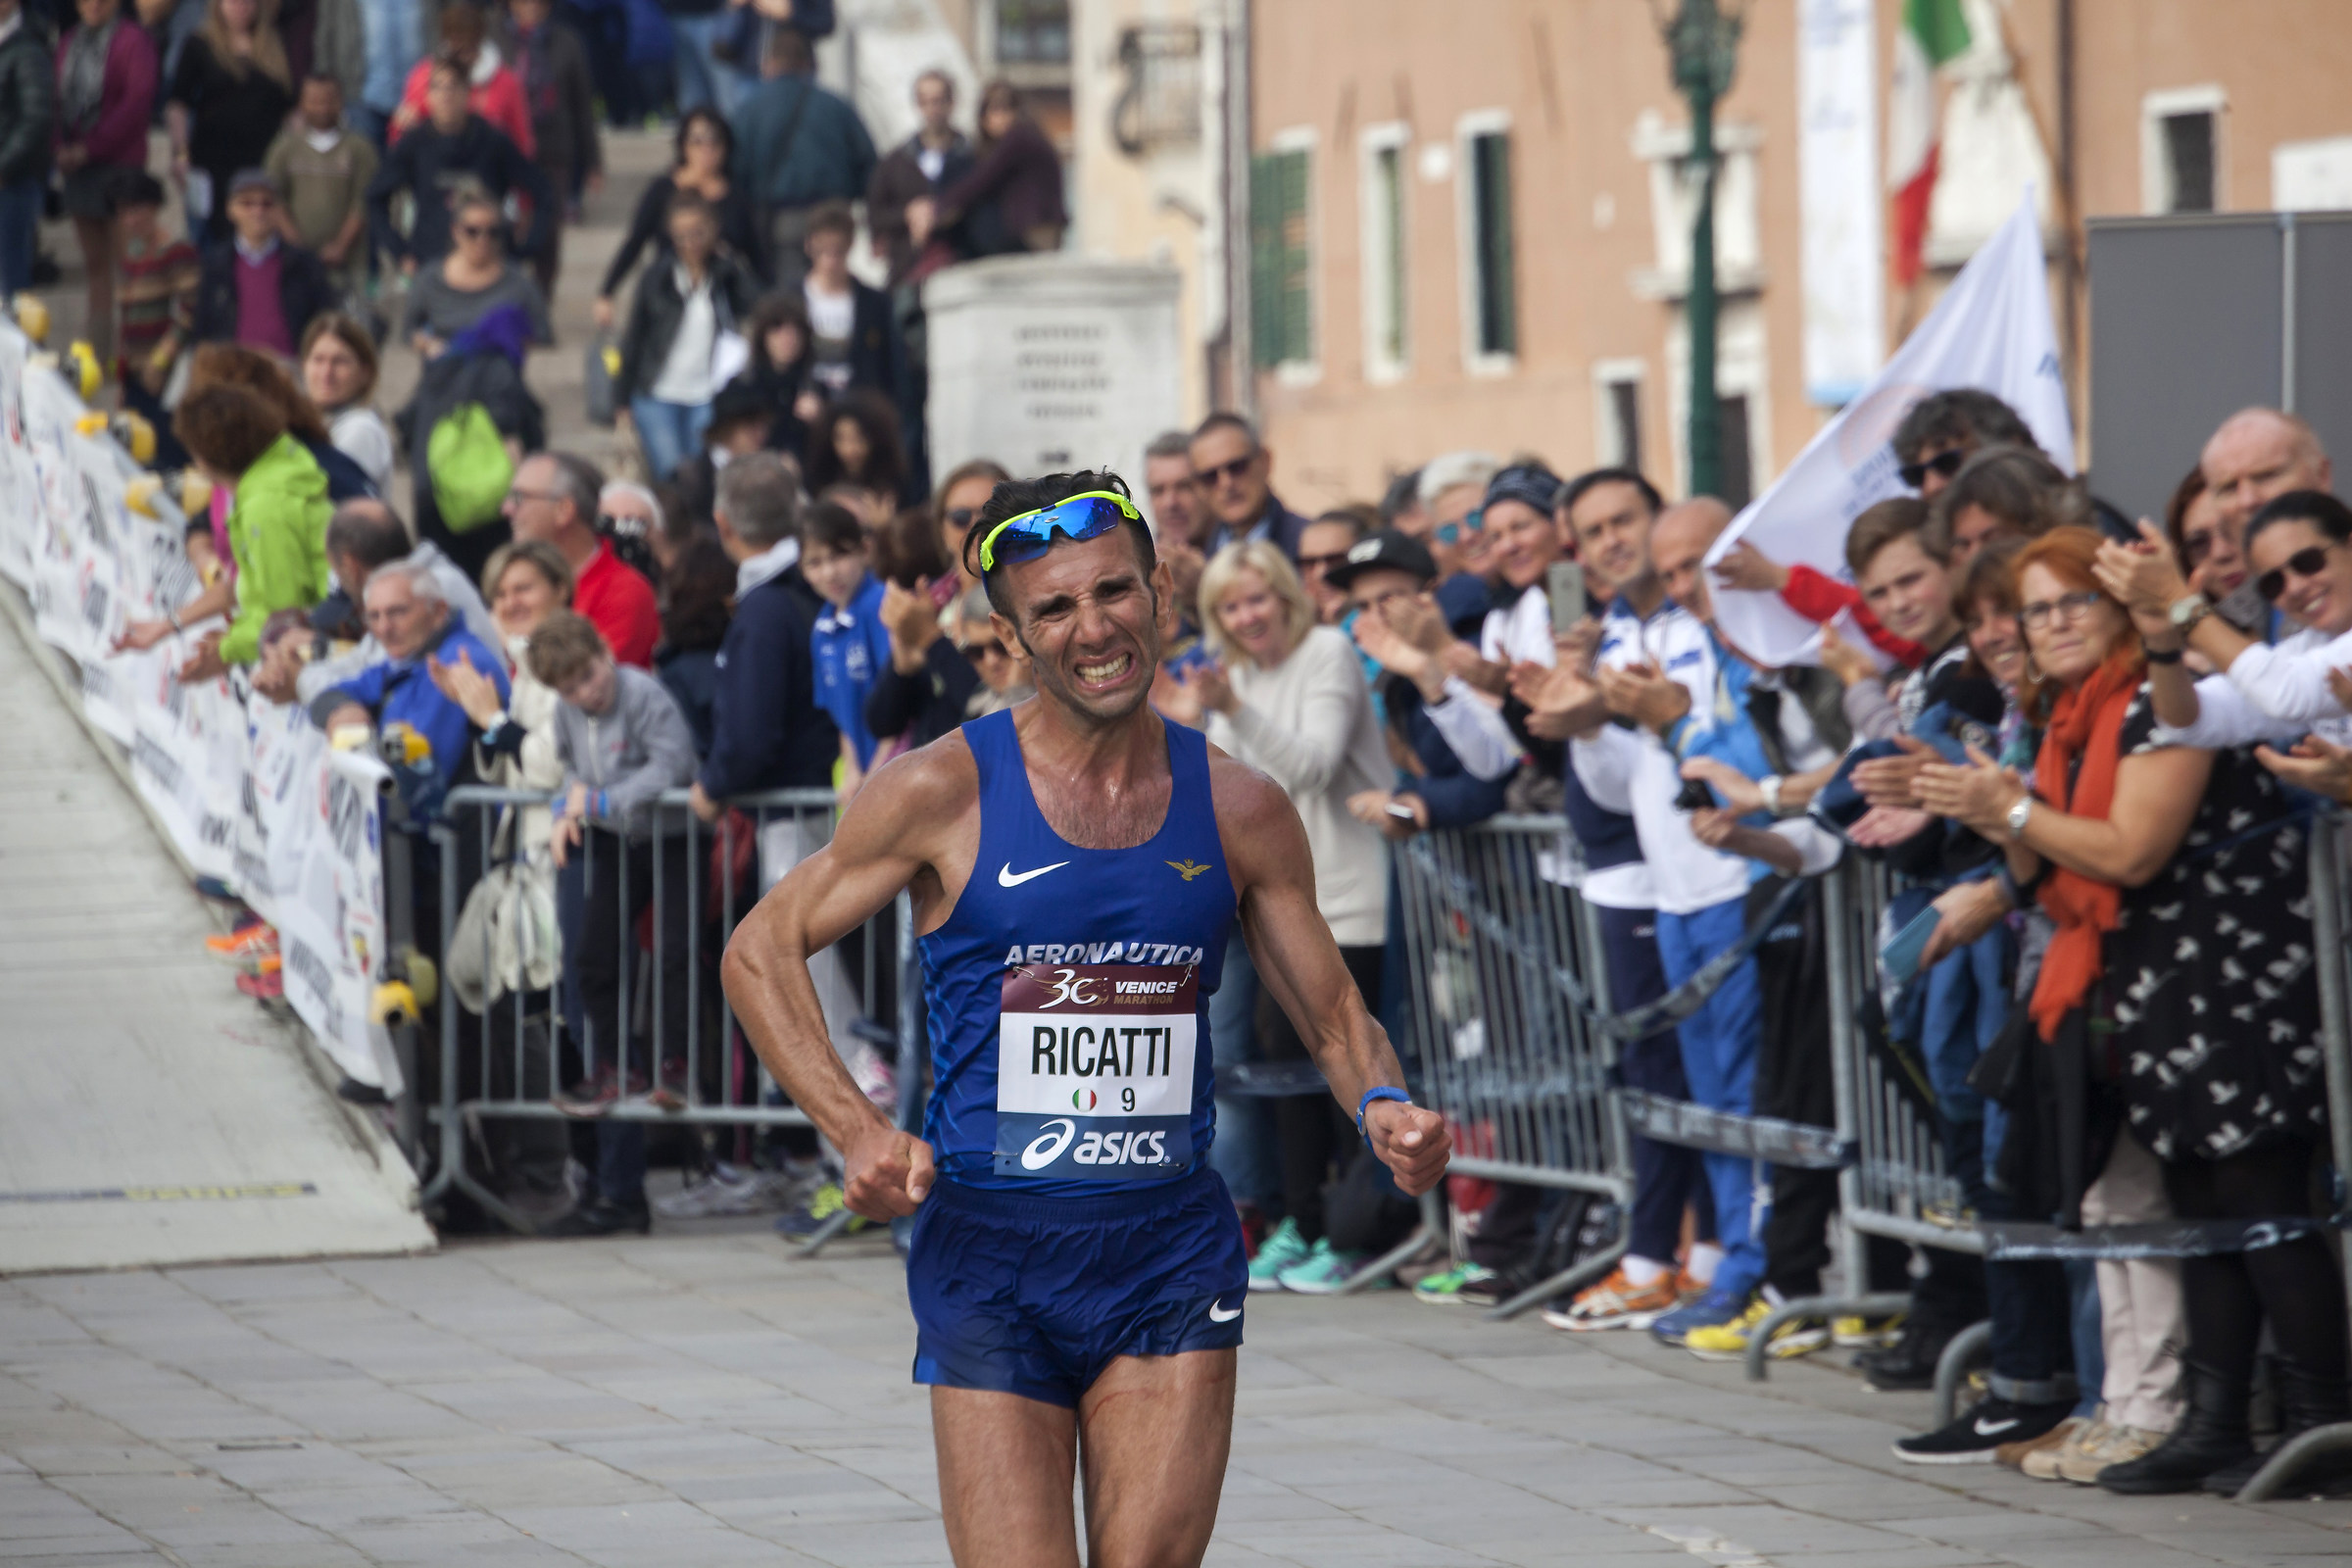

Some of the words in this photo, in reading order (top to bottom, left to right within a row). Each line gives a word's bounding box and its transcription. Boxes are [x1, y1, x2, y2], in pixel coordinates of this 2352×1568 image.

[1004, 941, 1203, 966] AERONAUTICA
[1113, 995, 1175, 1004] MARATHON
[1114, 981, 1178, 994] VENICE
[1031, 1025, 1172, 1078] RICATTI
[1121, 1087, 1137, 1112] 9
